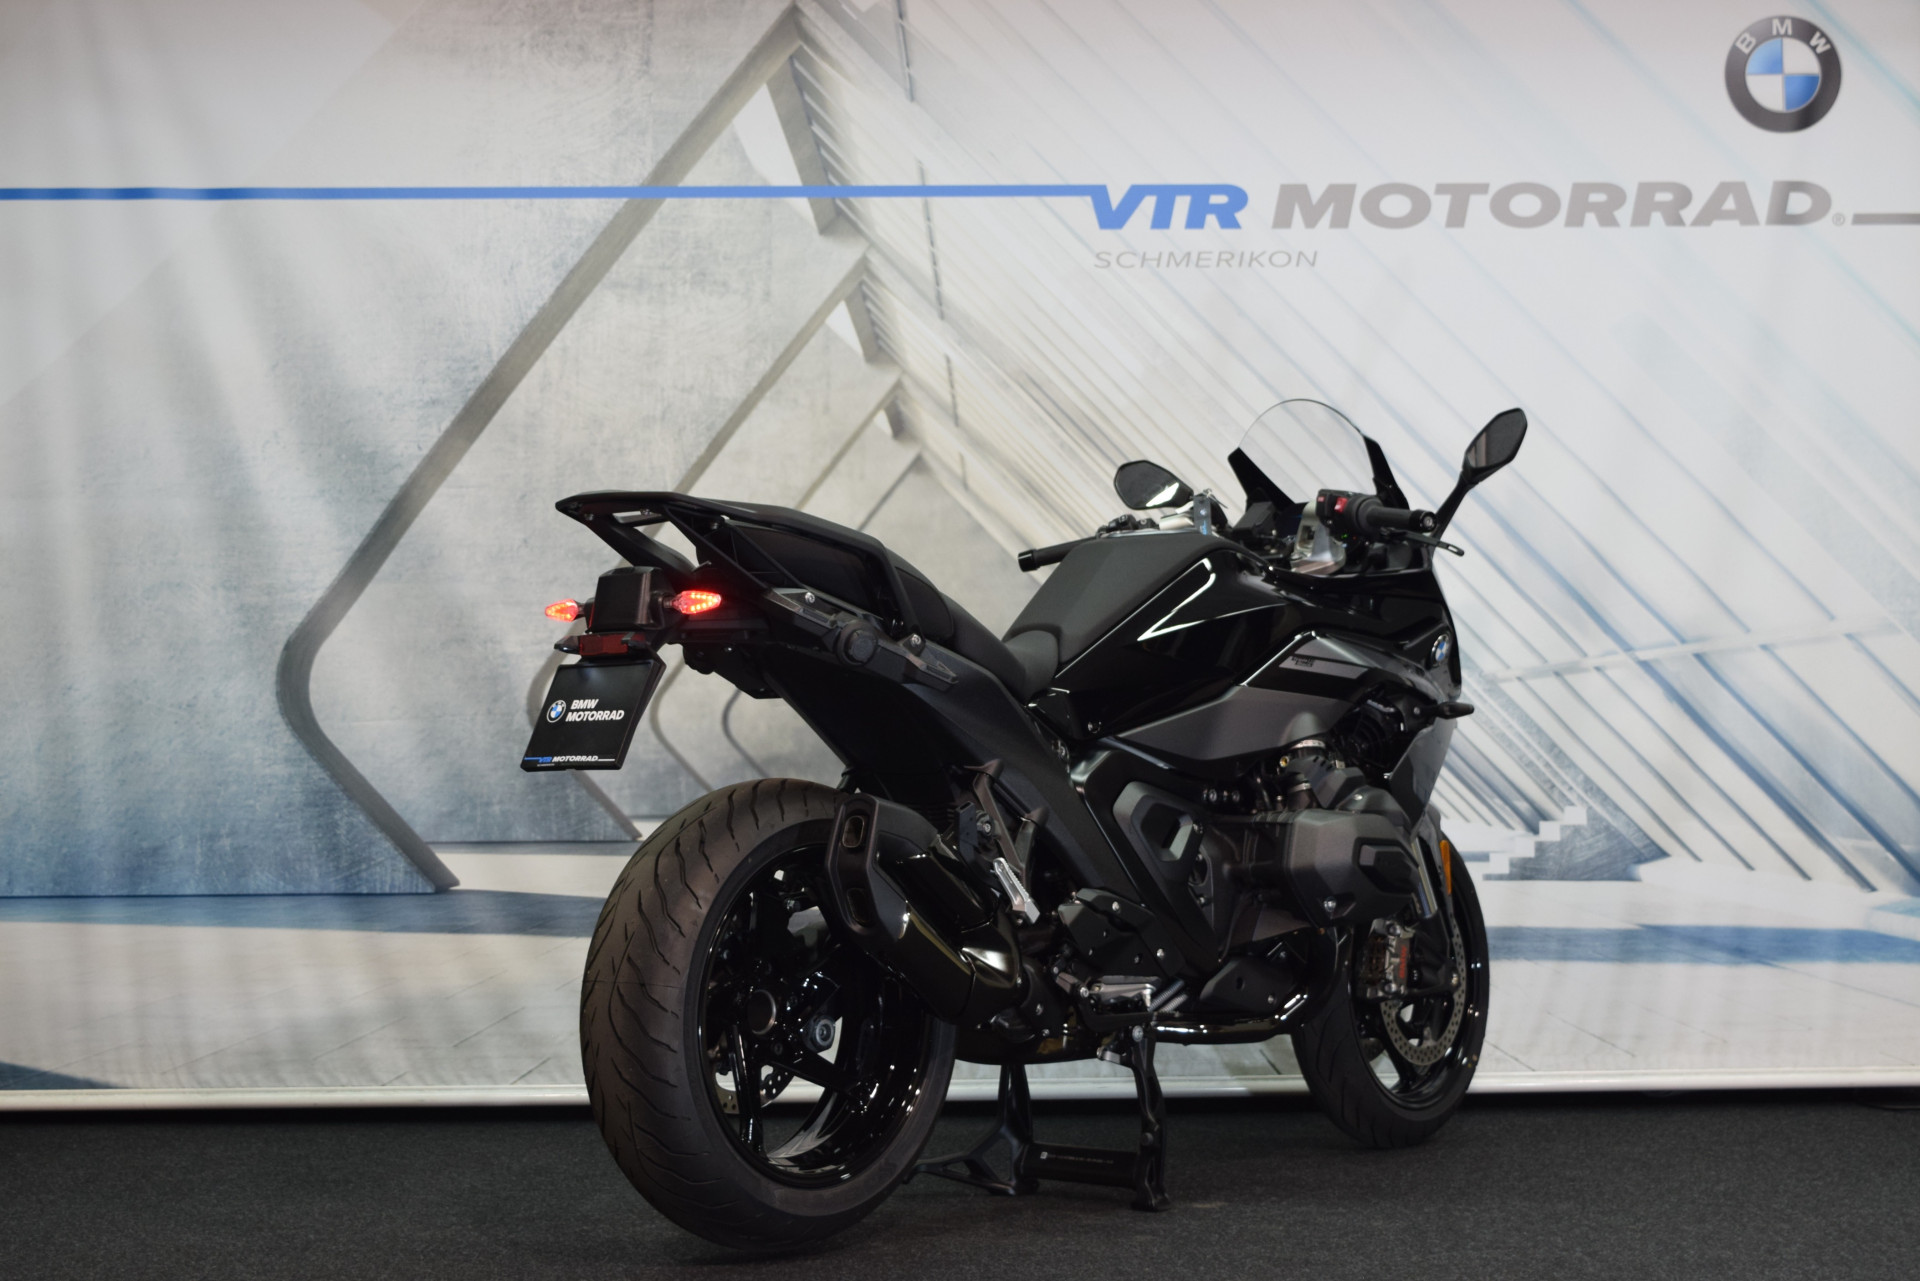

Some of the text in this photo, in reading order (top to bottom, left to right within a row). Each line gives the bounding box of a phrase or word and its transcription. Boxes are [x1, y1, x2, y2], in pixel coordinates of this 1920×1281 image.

[1735, 18, 1831, 54] BMW
[1090, 184, 1249, 230] VTR
[1094, 250, 1318, 269] SCHMERIKON
[570, 699, 599, 710] BMW
[565, 710, 625, 722] MOTORRAD
